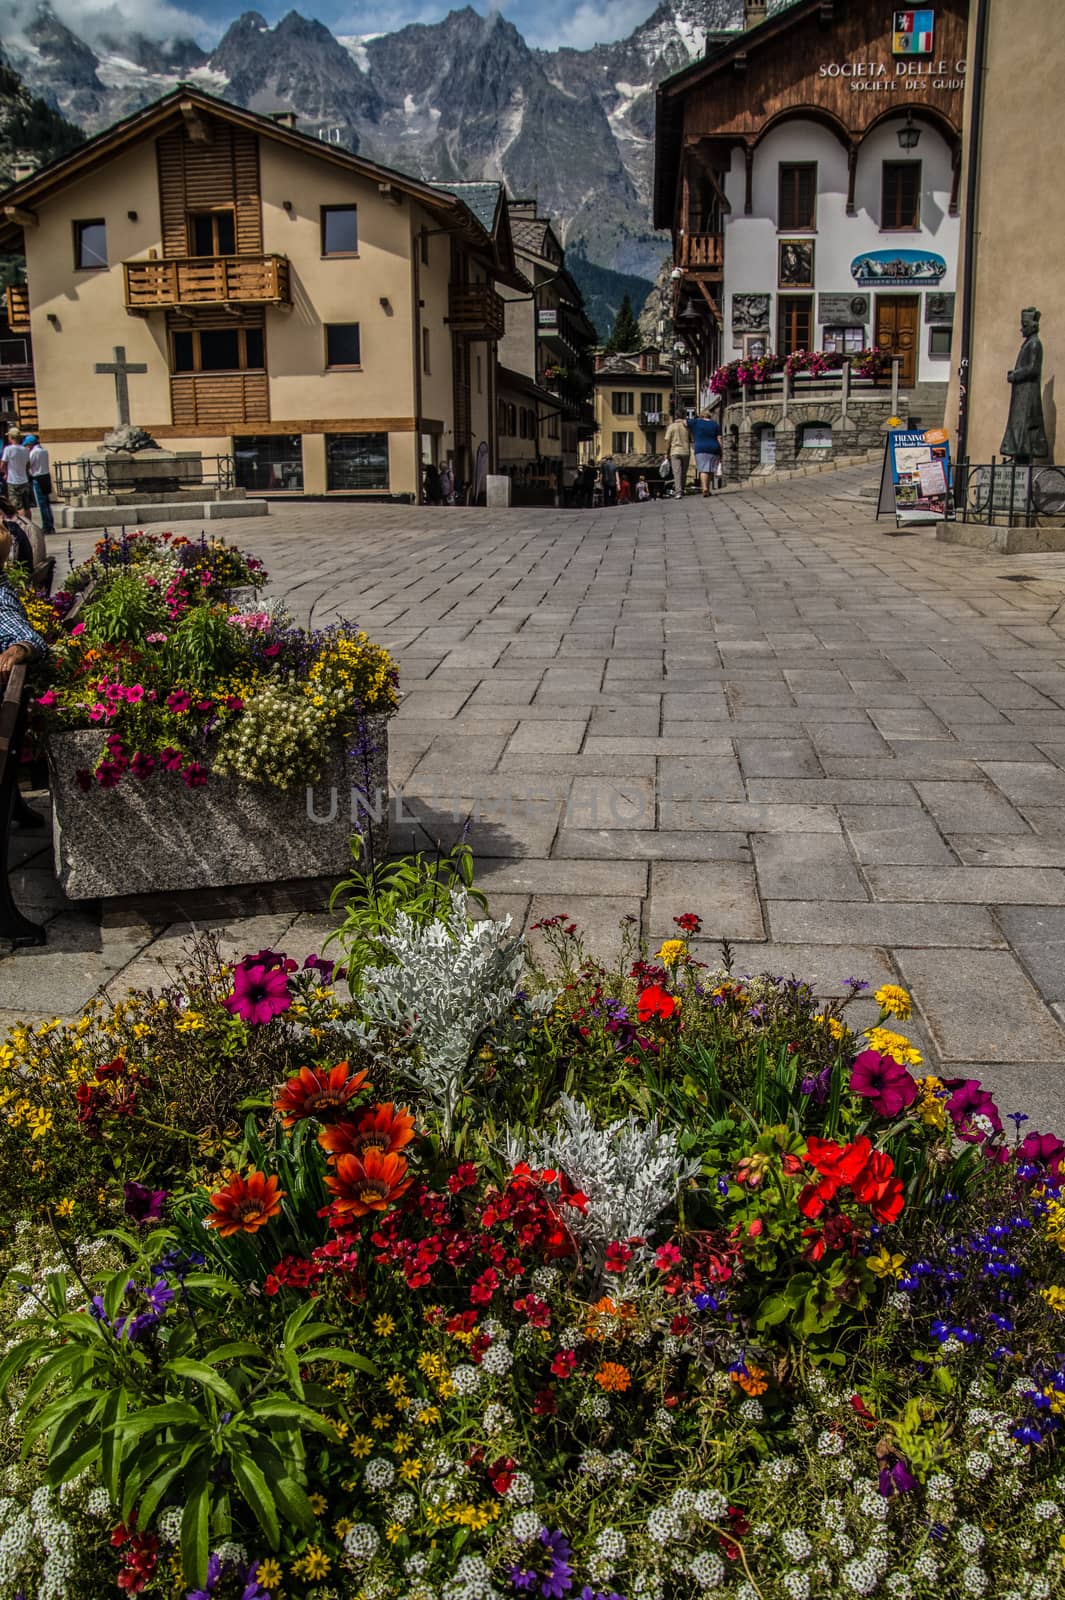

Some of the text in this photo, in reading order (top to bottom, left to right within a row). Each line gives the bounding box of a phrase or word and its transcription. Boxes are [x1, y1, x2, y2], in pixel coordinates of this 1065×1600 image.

[896, 60, 948, 75] DELLE
[905, 79, 927, 90] DES
[894, 434, 925, 442] TRENINO
